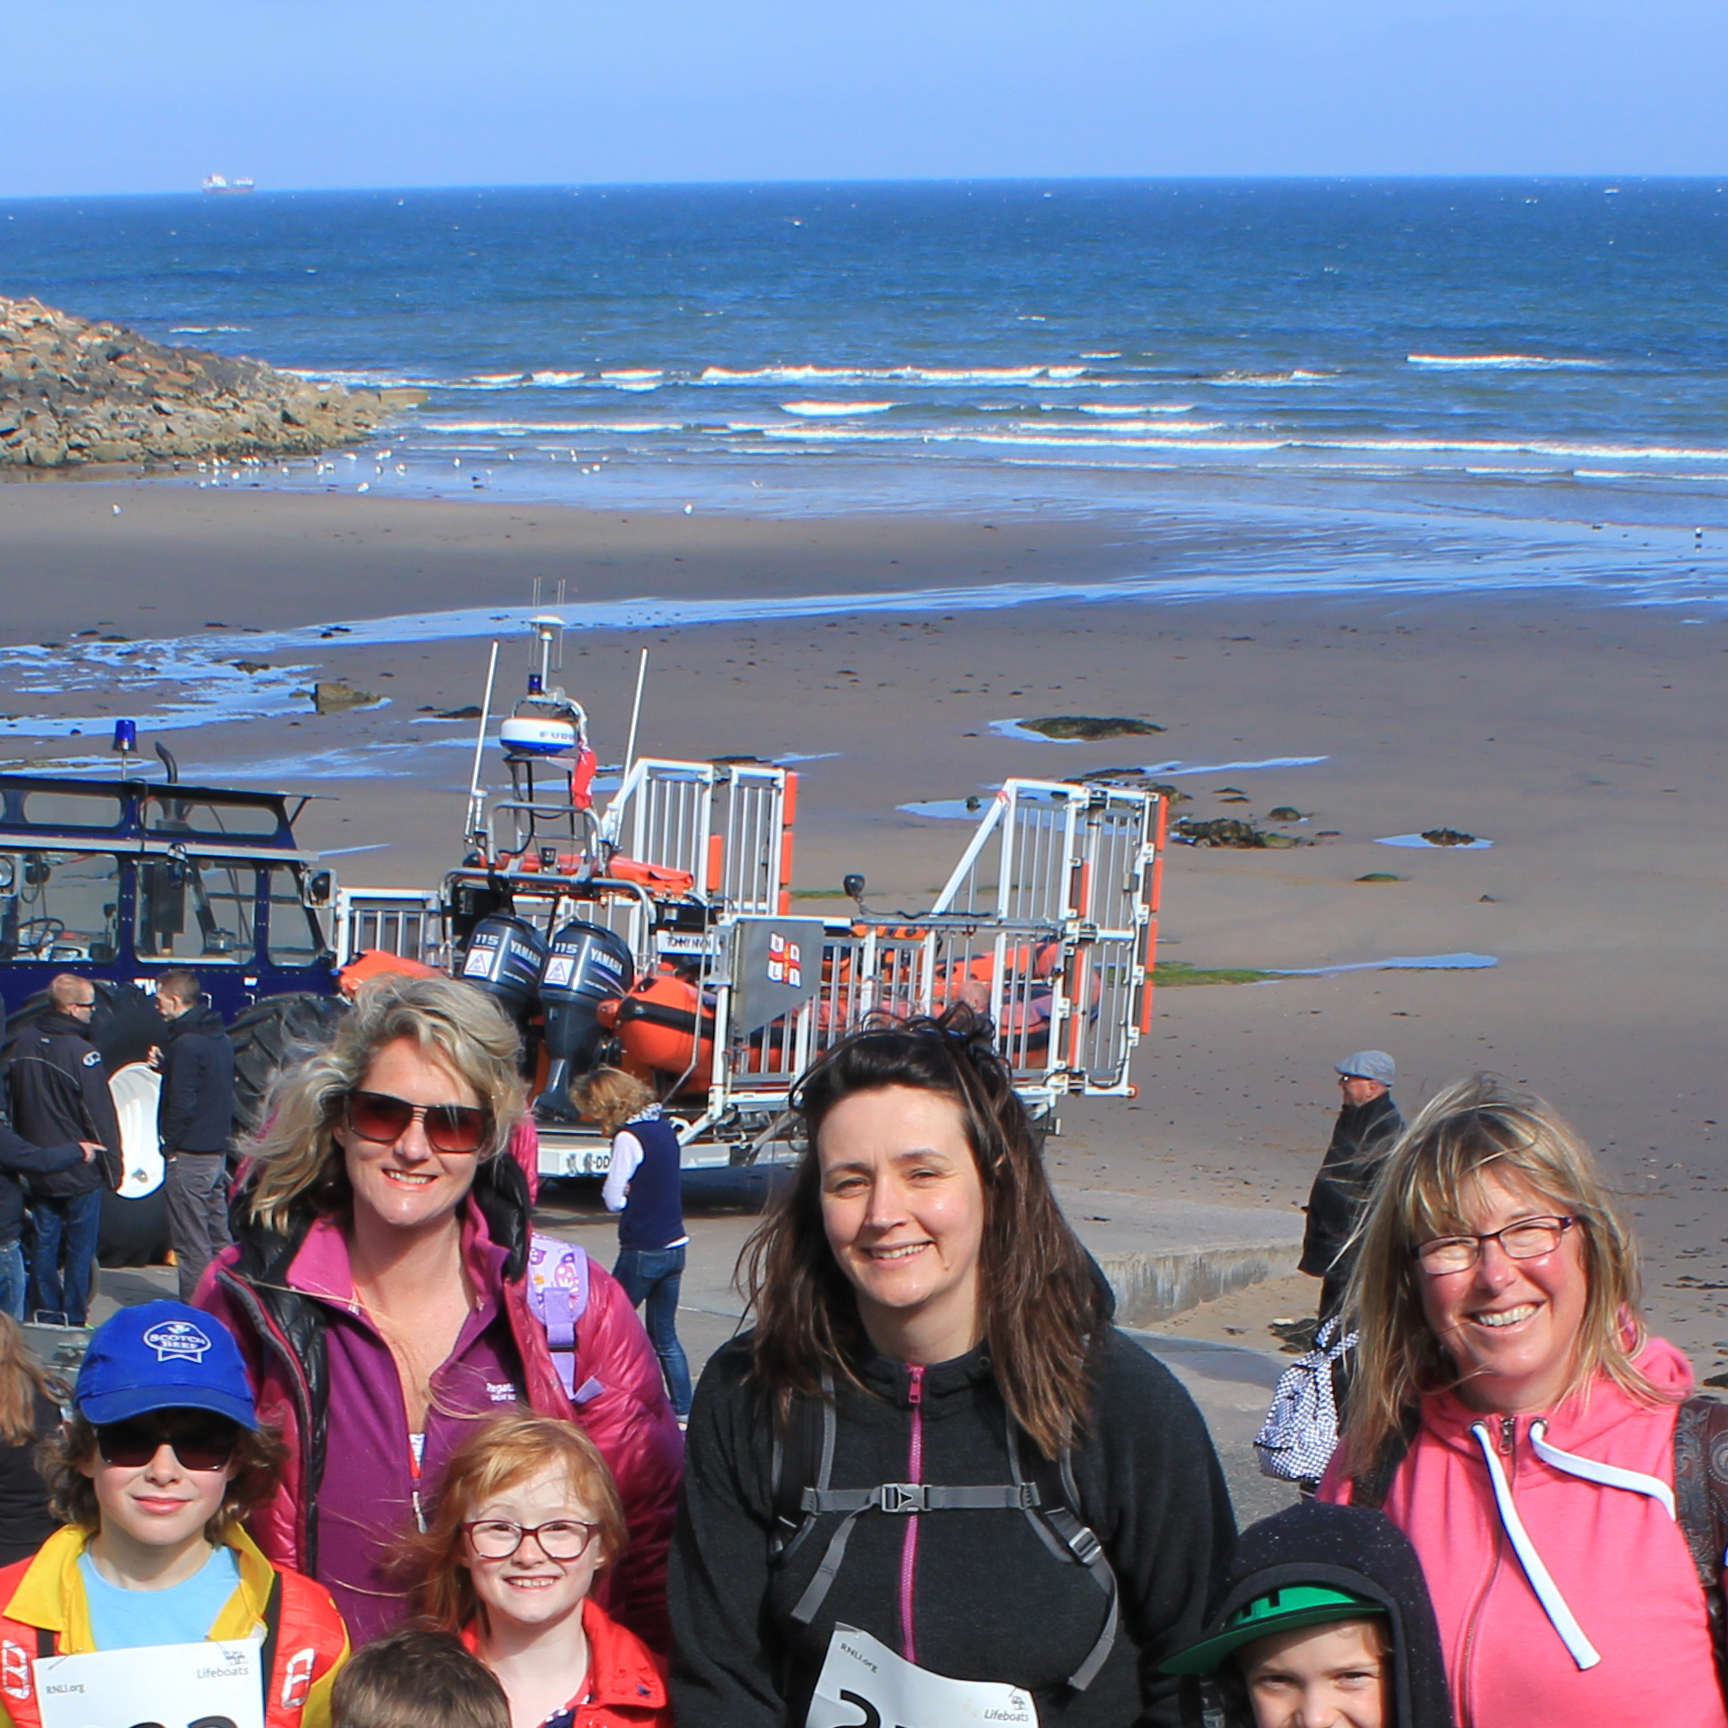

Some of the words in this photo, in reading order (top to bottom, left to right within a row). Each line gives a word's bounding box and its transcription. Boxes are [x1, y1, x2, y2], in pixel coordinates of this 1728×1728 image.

[475, 933, 500, 946] 115
[554, 942, 579, 954] 115
[149, 1333, 206, 1345] SCOTCH
[839, 1642, 879, 1674] RNLI.org
[196, 1666, 251, 1679] Lifeboats
[45, 1683, 87, 1695] RNLI.org
[983, 1708, 1030, 1722] Lifeboats
